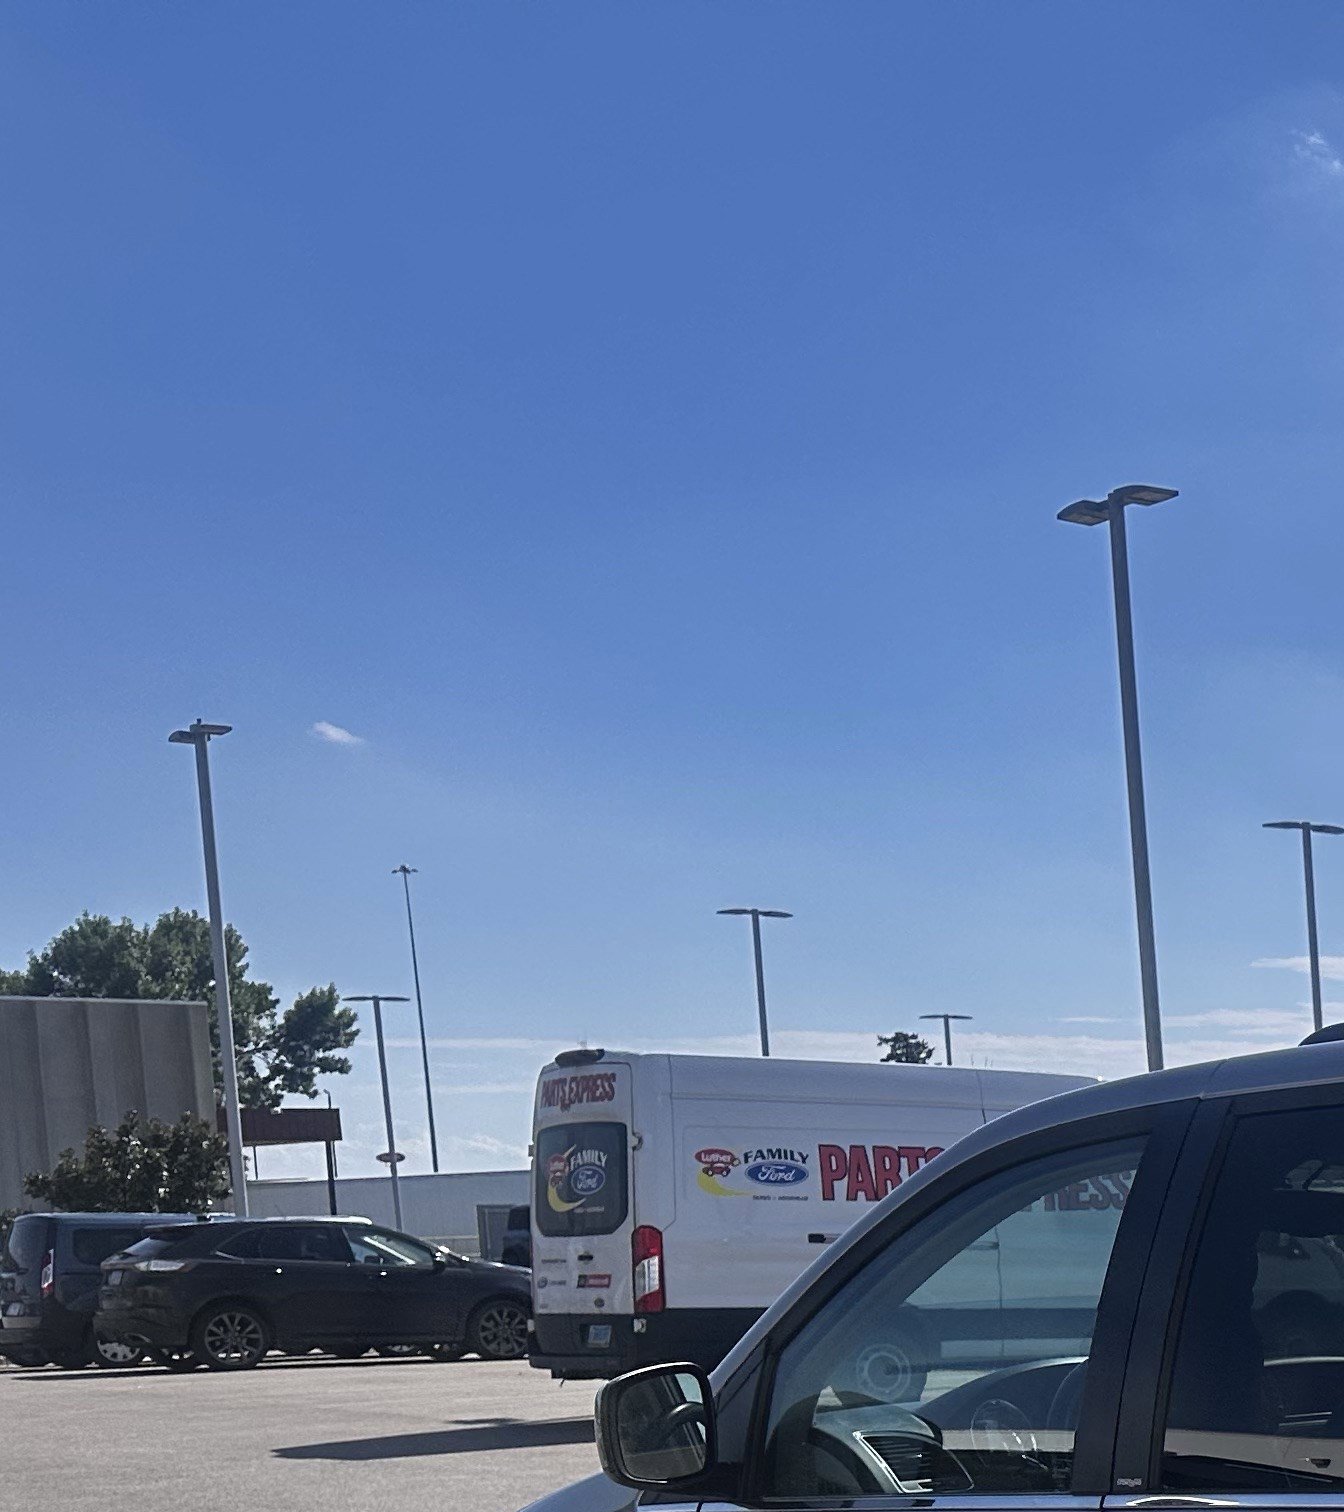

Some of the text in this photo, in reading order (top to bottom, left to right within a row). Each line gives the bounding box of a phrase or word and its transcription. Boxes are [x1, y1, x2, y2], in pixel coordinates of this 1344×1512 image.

[541, 1073, 616, 1112] PARTS EXPRESS
[570, 1149, 608, 1172] FAMILY
[743, 1147, 809, 1164] FAMILY
[758, 1165, 796, 1181] Ford
[818, 1144, 948, 1201] PART
